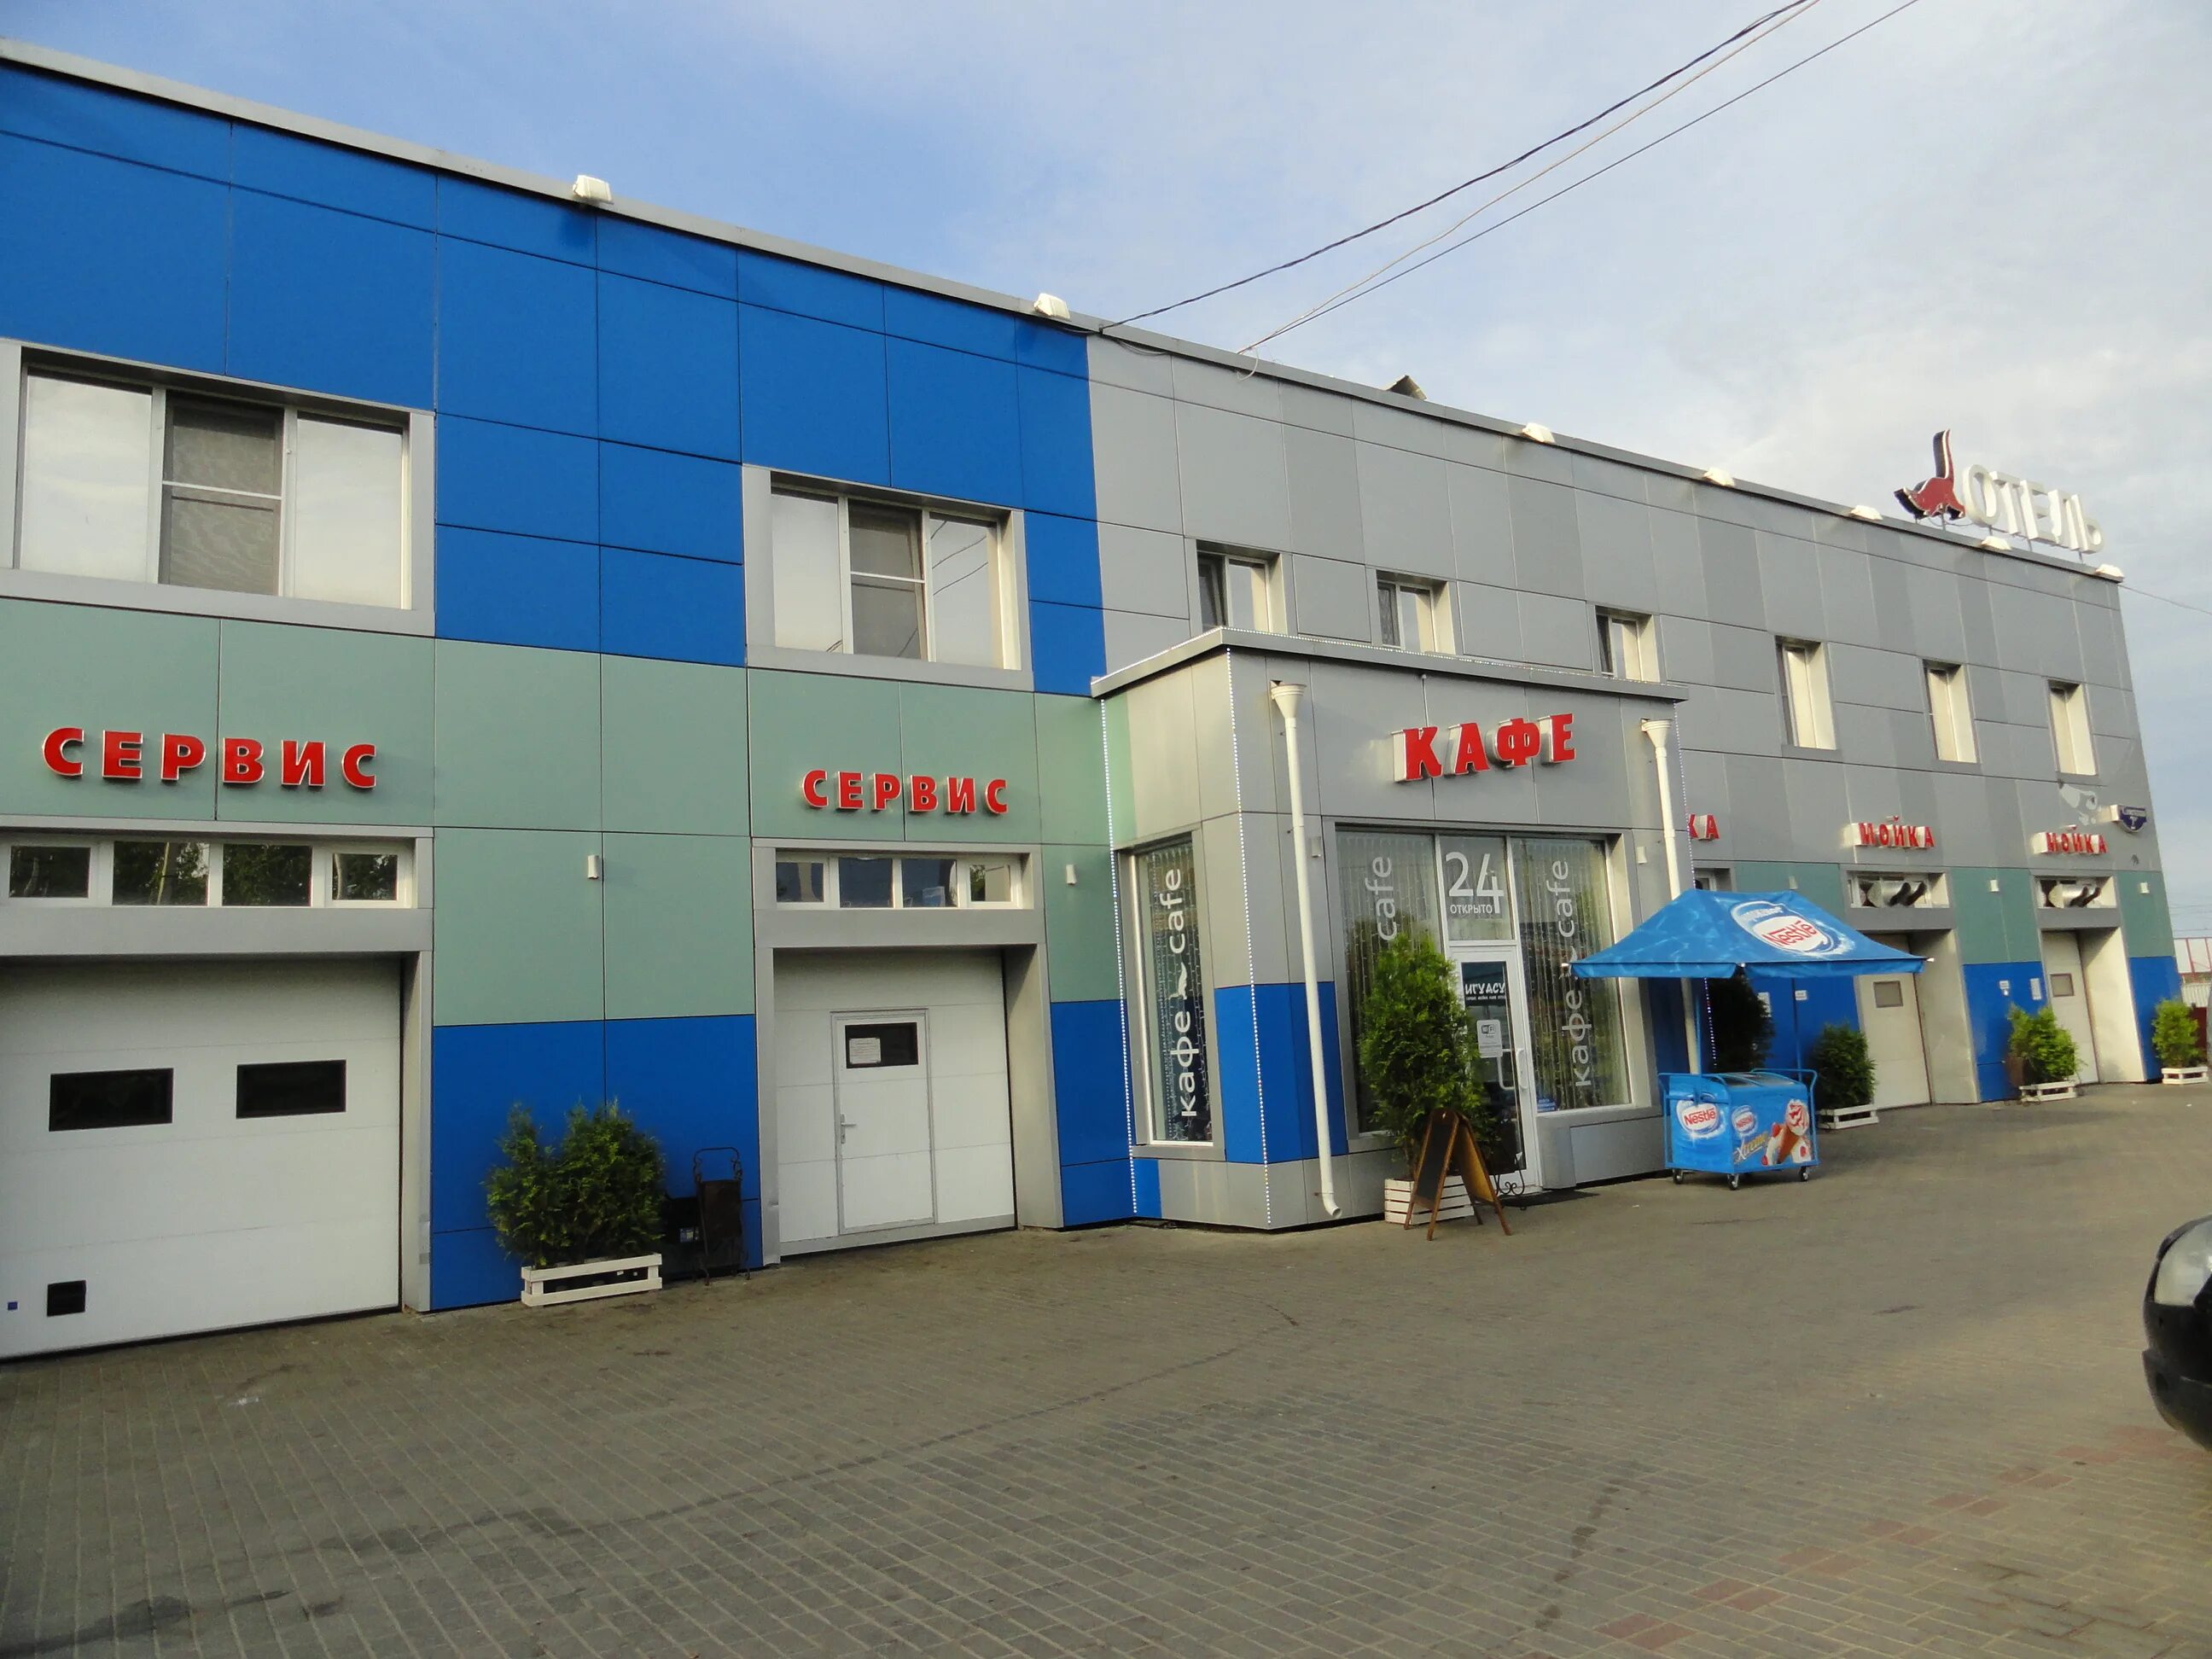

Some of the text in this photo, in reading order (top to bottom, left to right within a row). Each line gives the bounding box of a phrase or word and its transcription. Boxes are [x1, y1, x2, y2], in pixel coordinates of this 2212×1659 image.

[1963, 464, 2104, 555] ОТЕЛЬ
[43, 727, 376, 789] СЕРВИС
[1400, 713, 1576, 781] КАФЕ
[802, 769, 1009, 814] СЕРВИС
[1855, 815, 1935, 847] МОЙКА
[2045, 824, 2108, 853] МОЙКА
[1365, 856, 1398, 940] cafe
[1446, 852, 1504, 913] 24
[1450, 904, 1493, 915] ОТКРЫТО
[1160, 868, 1200, 1116] кафе cafe
[1464, 982, 1506, 995] ИГУАСУ
[1545, 859, 1592, 1087] кафе cafe
[1684, 1108, 1716, 1126] Nestlé
